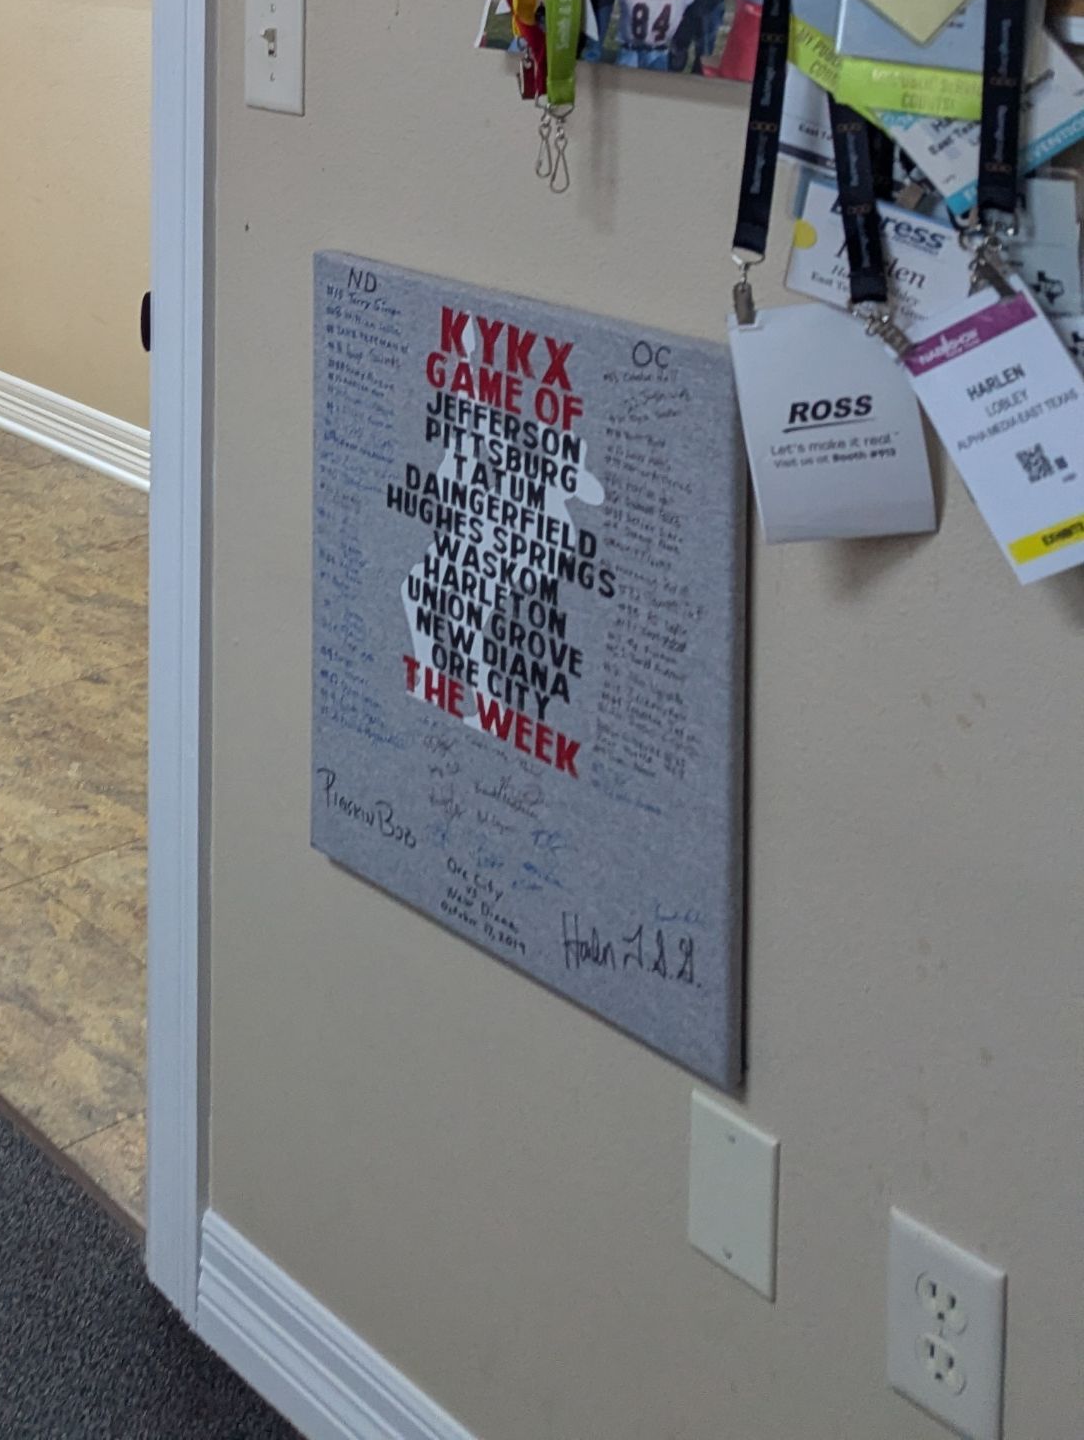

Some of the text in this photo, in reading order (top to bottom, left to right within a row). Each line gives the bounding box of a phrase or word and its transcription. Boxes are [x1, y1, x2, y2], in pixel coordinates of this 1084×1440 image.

[632, 2, 672, 42] 84
[347, 267, 378, 294] ND
[441, 306, 575, 392] KYKX
[632, 340, 672, 370] OC
[967, 363, 1026, 401] HARLEN
[426, 351, 523, 415] GAME
[534, 387, 584, 432] OF
[426, 391, 582, 464] JEFFERSON
[788, 395, 873, 425] ROSS
[985, 388, 1028, 418] LOBLEY
[425, 416, 578, 494] PITTSBURG
[453, 454, 546, 512] TATUM
[770, 438, 860, 457] Let's make it
[387, 484, 616, 599] HUGHES SPRINGS
[406, 463, 597, 559] DAINGERFIELD
[424, 554, 567, 639] HARLETON
[434, 531, 559, 607] WASKOM
[408, 575, 584, 679] UNION GROVE
[416, 606, 571, 705] NEW DIANA
[403, 653, 582, 780] THE WEEK
[432, 643, 550, 721] ORE CITY
